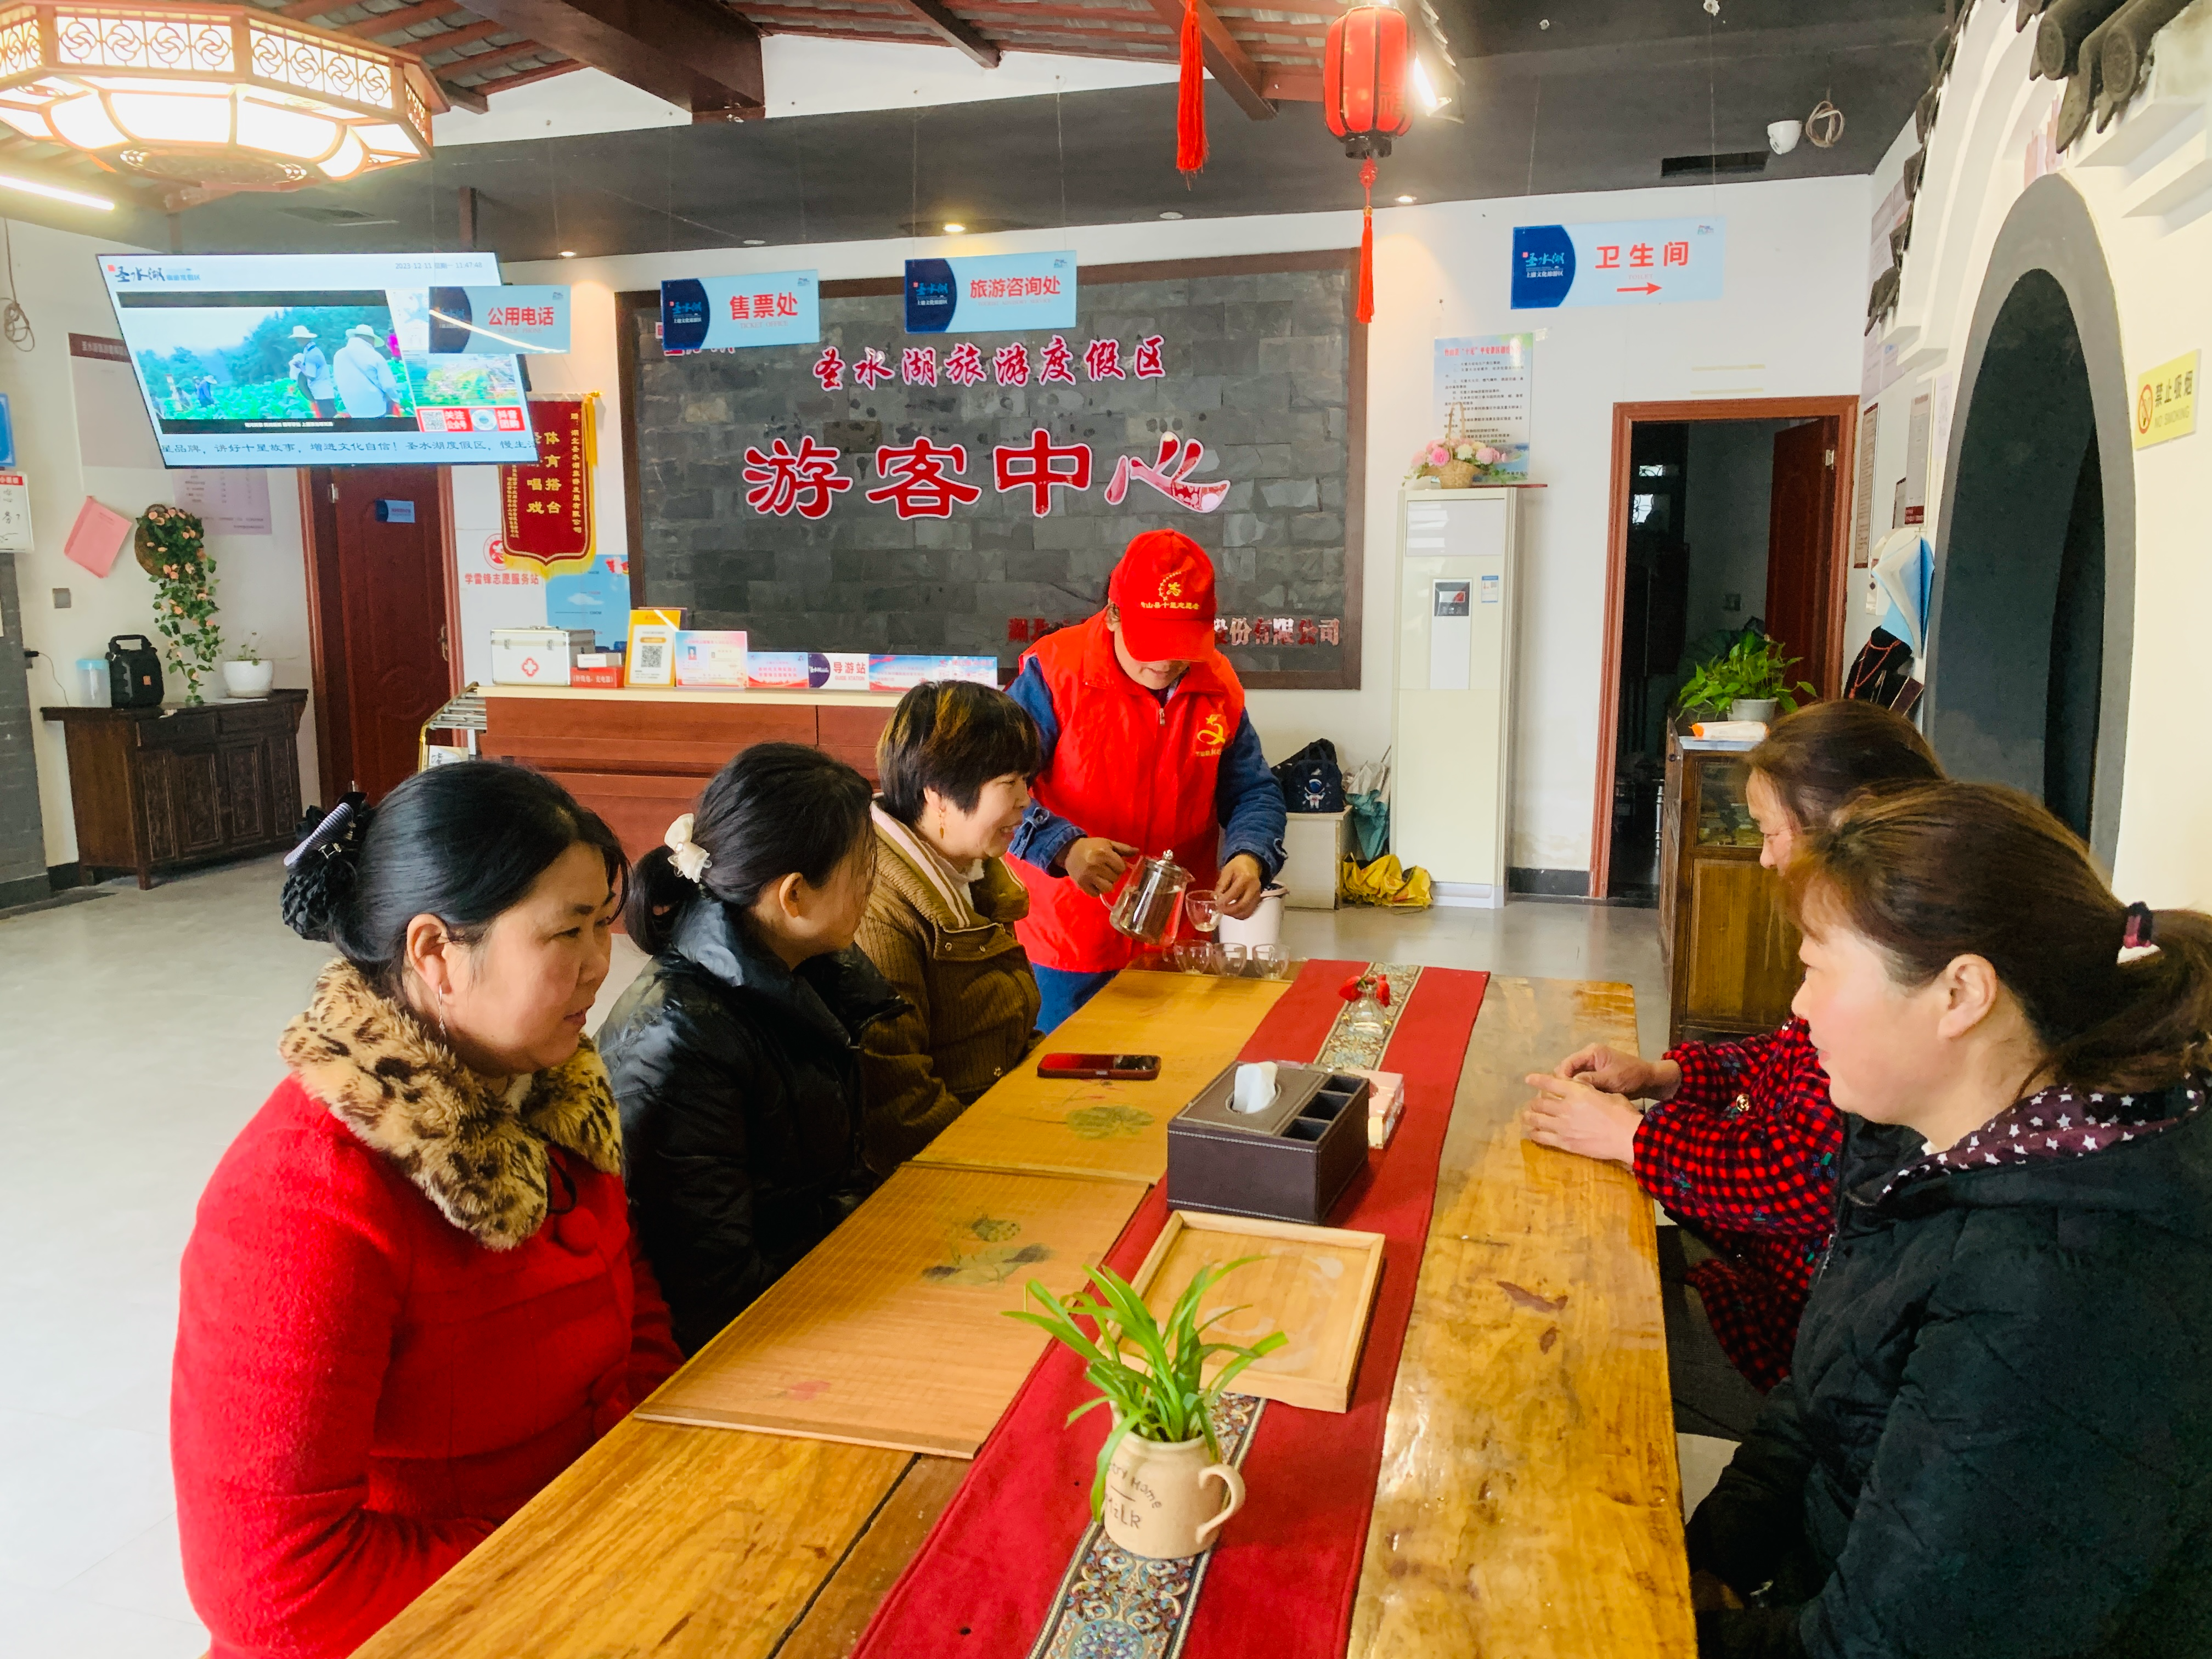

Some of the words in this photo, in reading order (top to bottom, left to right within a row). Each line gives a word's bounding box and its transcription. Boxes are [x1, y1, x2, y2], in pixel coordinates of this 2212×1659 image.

[1525, 252, 1565, 267] 圣水湖
[1595, 241, 1689, 269] 卫生间
[970, 275, 1061, 299] 旅游咨询处
[487, 306, 555, 326] 公用电话
[730, 292, 798, 320] 售票处
[812, 334, 1166, 392] 圣水湖旅游度假区
[2154, 370, 2193, 408] 禁止吸烟
[544, 431, 562, 515] 体育搭台
[744, 427, 1232, 520] 游客中心
[465, 573, 539, 585] 学雷锋志愿服务站
[833, 662, 866, 674] 导游站
